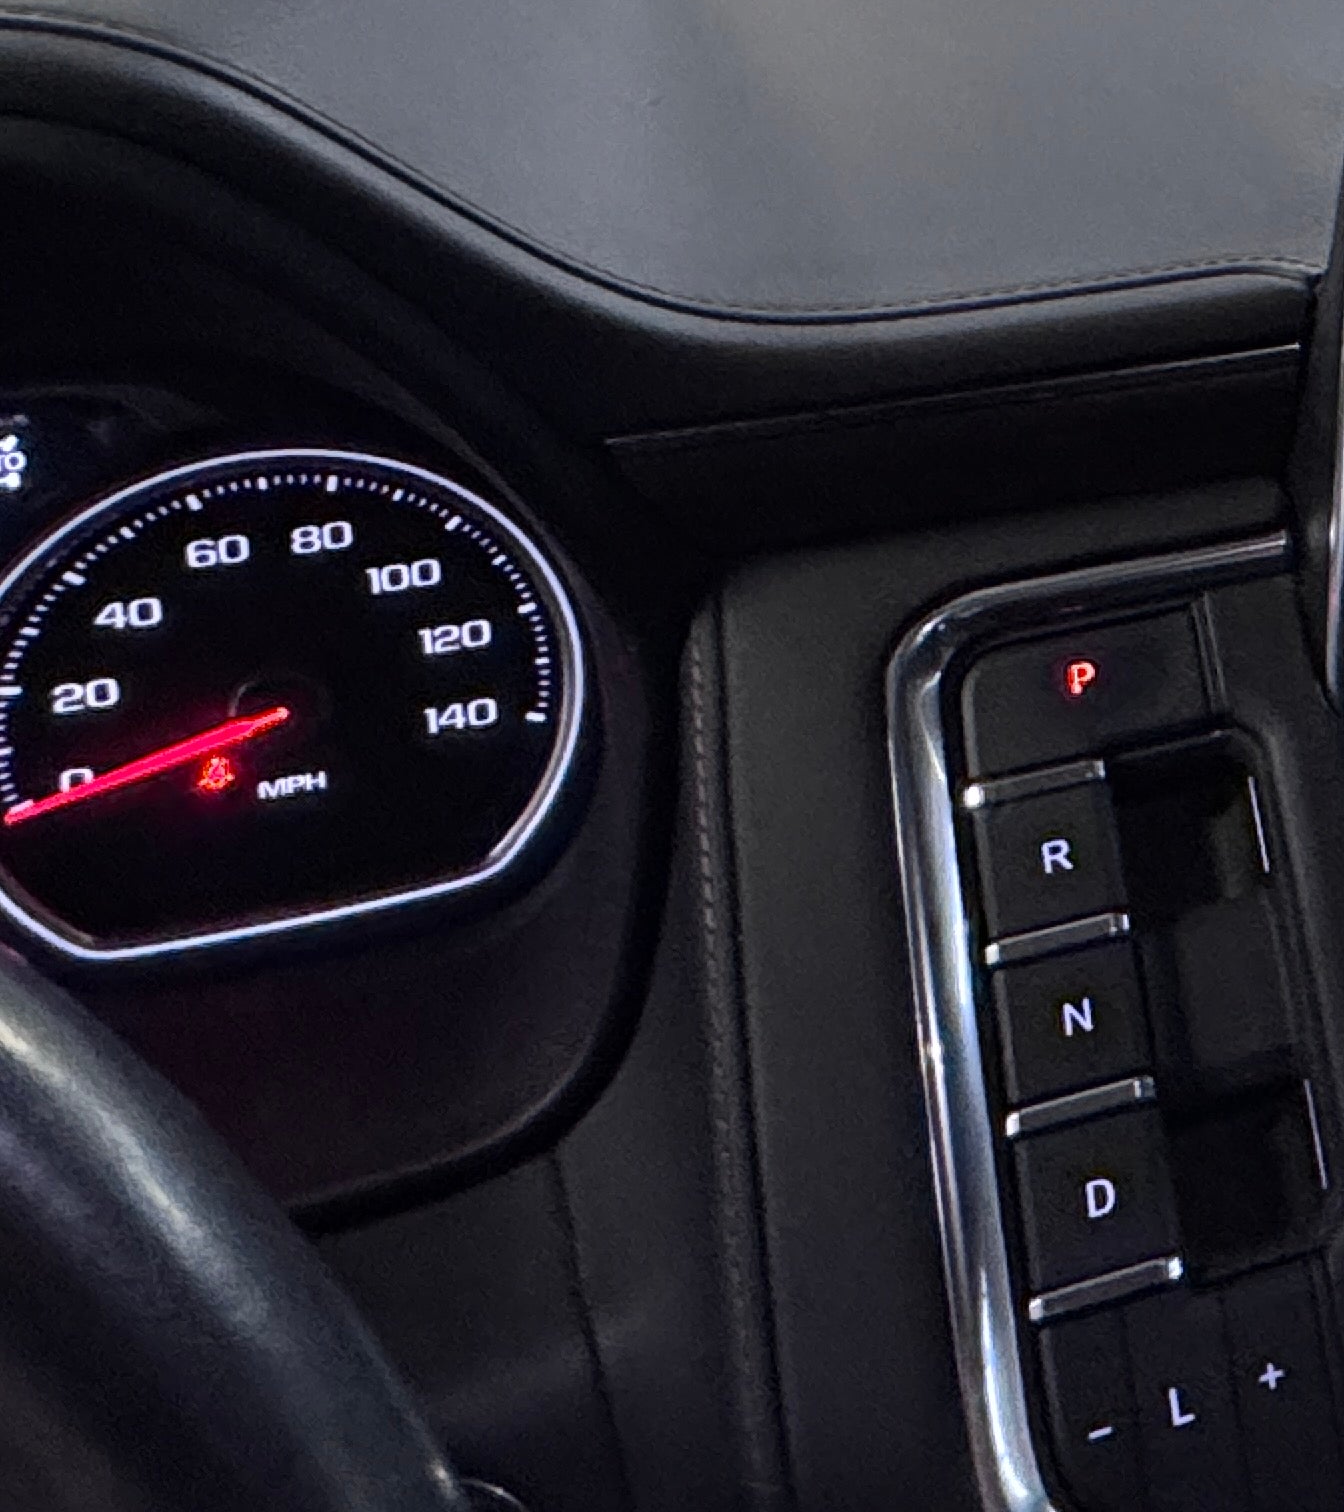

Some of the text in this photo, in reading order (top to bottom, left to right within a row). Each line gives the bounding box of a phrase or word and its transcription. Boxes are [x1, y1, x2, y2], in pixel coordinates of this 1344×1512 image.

[186, 534, 250, 568] 60
[290, 520, 354, 554] 80
[366, 558, 442, 595] 100
[94, 597, 163, 630] 40
[418, 618, 492, 655] 120
[52, 678, 120, 714] 20
[1066, 661, 1096, 695] P
[424, 697, 498, 734] 140
[59, 768, 96, 795] 0
[256, 770, 328, 800] MPH
[1040, 838, 1074, 874] R
[1062, 997, 1094, 1036] N
[1084, 1178, 1116, 1219] D
[1168, 1387, 1196, 1427] L
